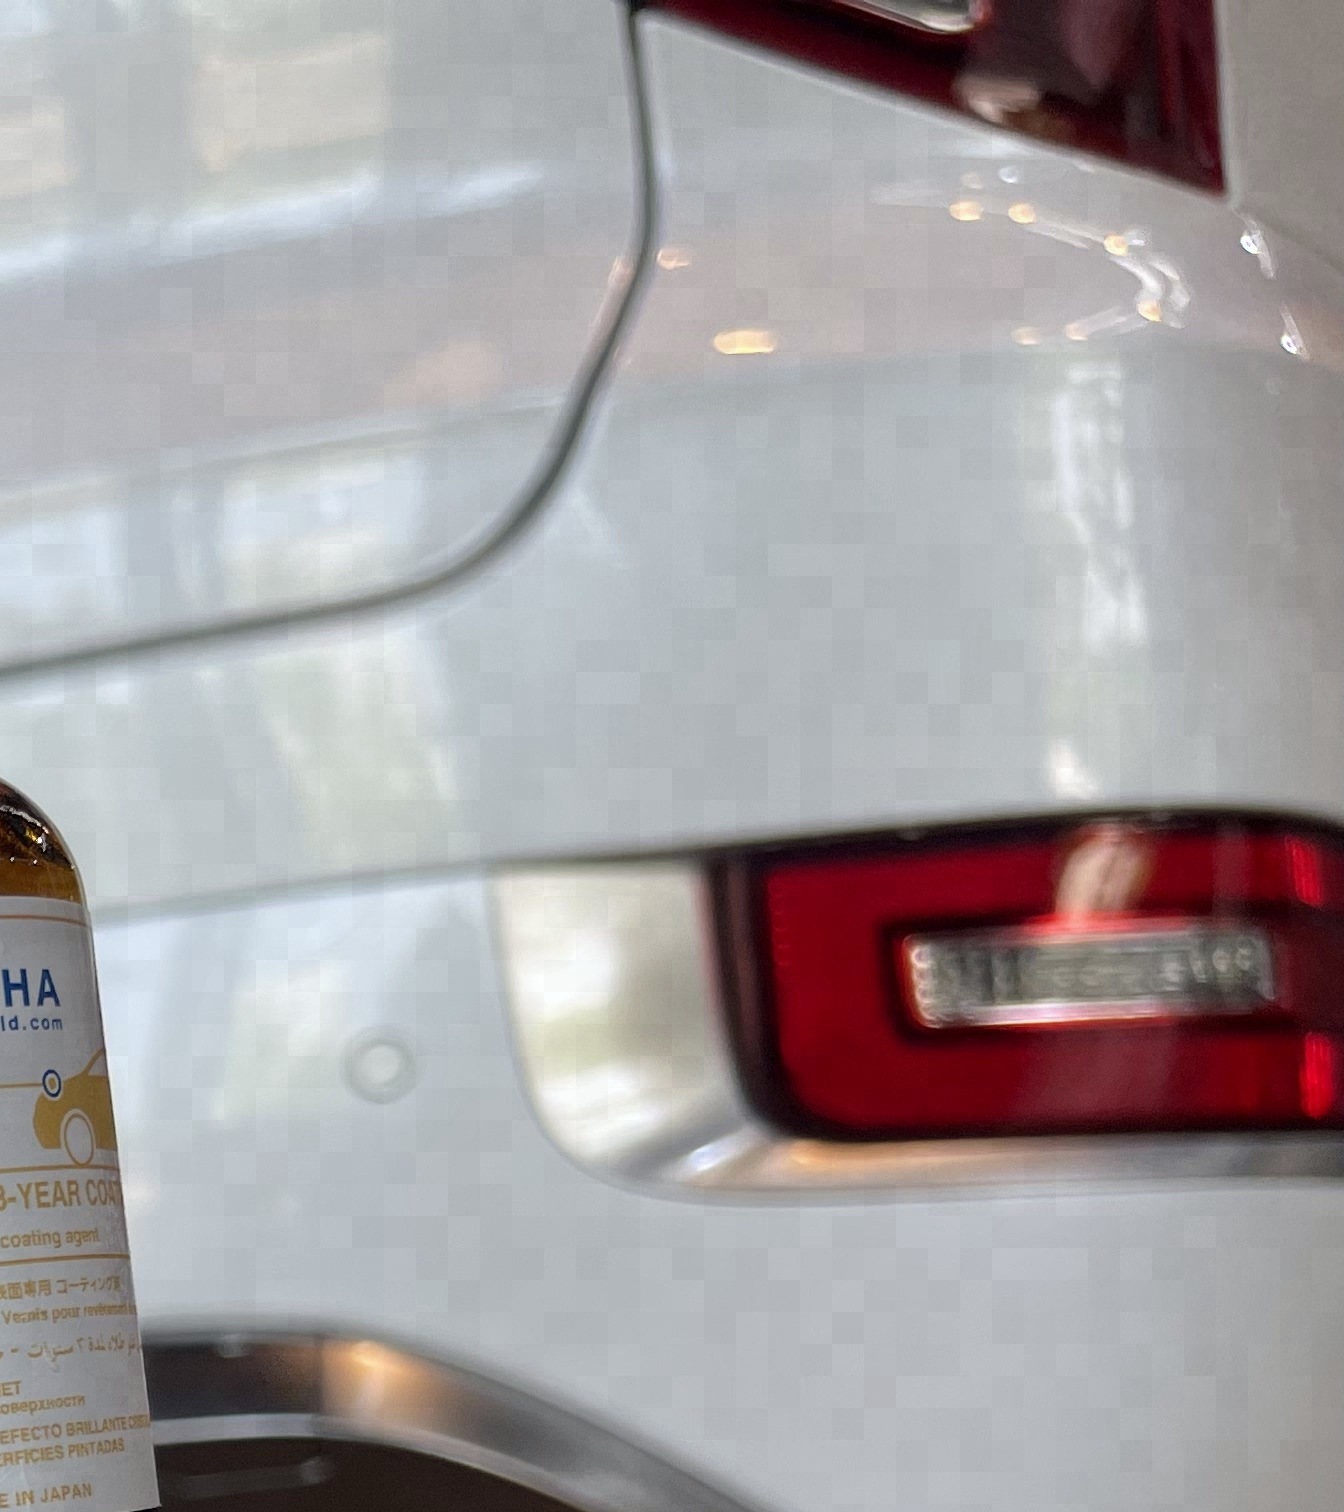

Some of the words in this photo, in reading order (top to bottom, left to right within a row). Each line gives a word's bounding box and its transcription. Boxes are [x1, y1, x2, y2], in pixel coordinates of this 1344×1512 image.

[0, 1228, 61, 1251] coating
[52, 1305, 79, 1323] pour
[0, 1423, 62, 1445] EFECTO
[68, 1437, 125, 1459] PINTADAS
[16, 1490, 35, 1507] IN
[40, 1483, 92, 1502] JAPAN
